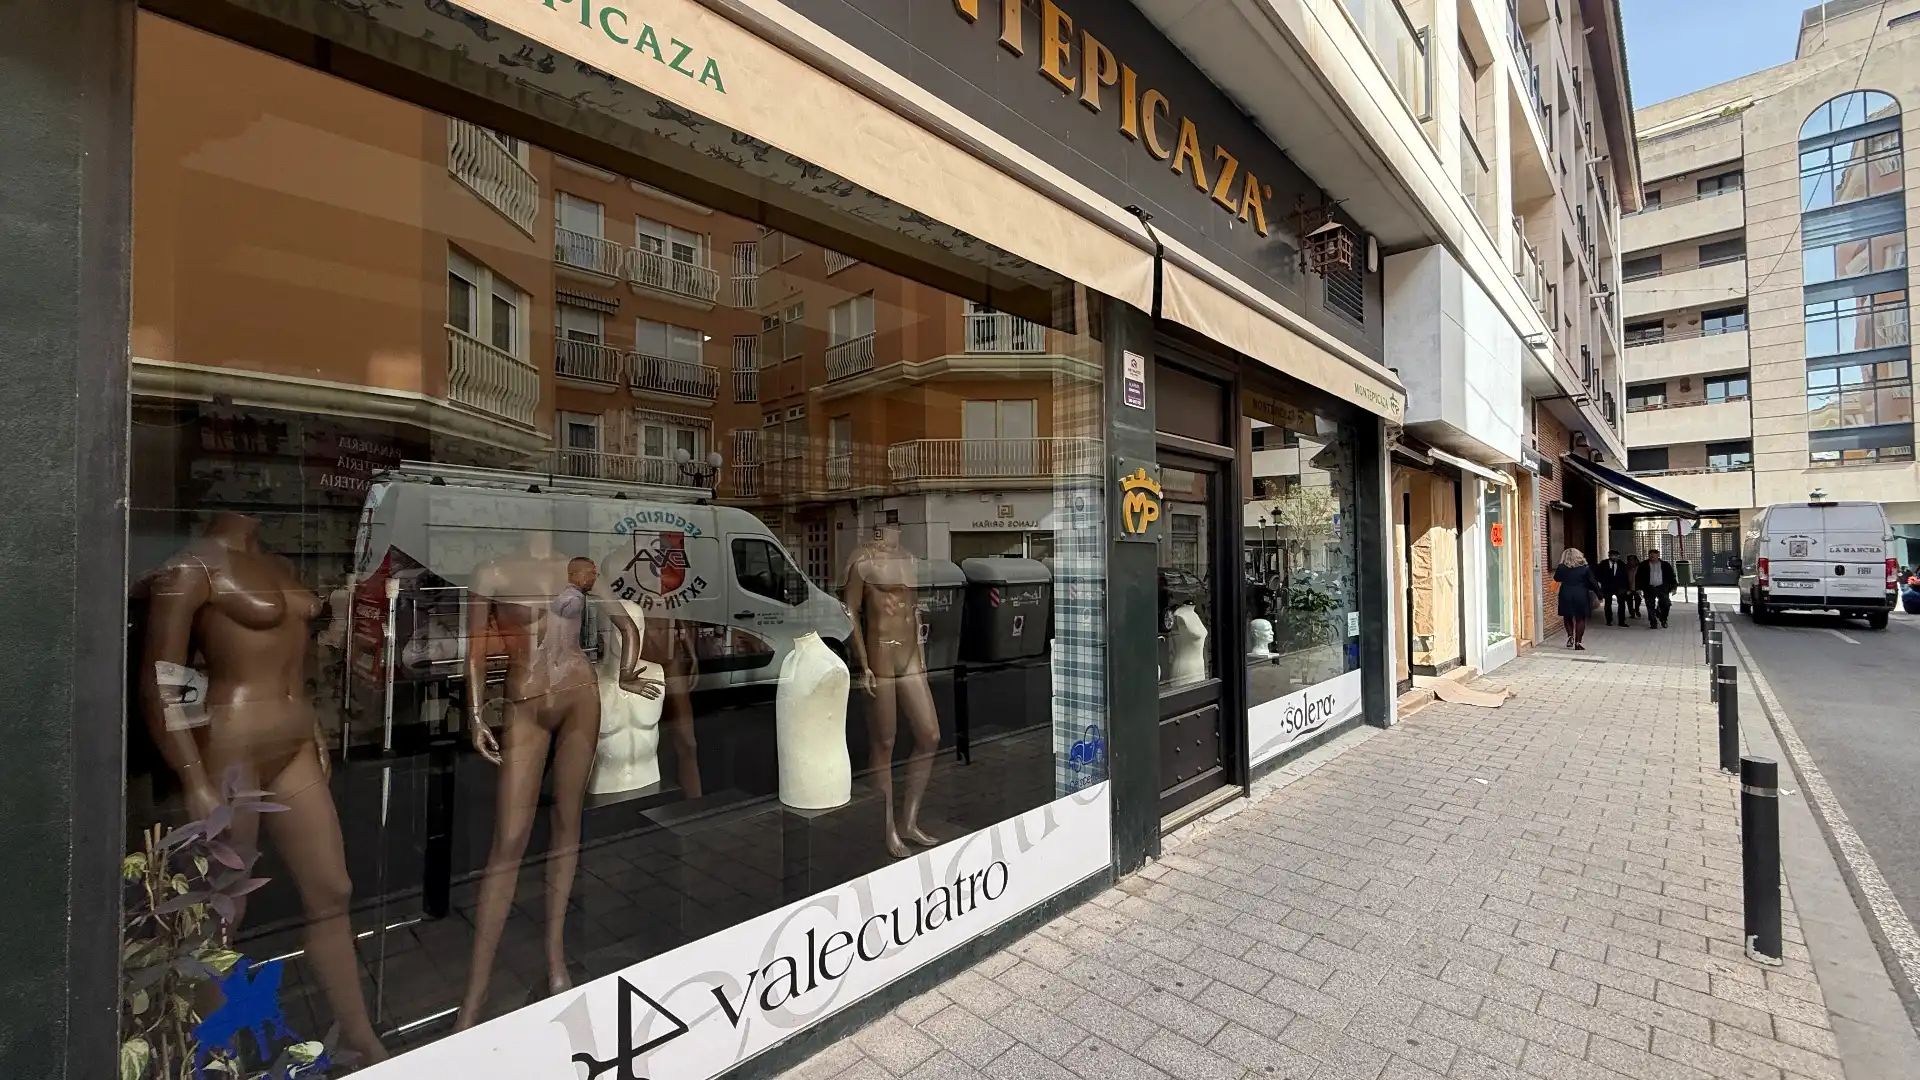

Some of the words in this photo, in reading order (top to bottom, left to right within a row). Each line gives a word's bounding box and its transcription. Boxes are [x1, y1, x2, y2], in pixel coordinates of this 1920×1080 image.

[951, 0, 1270, 239] TEPICAZA
[1354, 382, 1390, 409] MONTEPICAZA
[1285, 692, 1333, 734] solera
[710, 859, 1009, 1029] valecuatro
